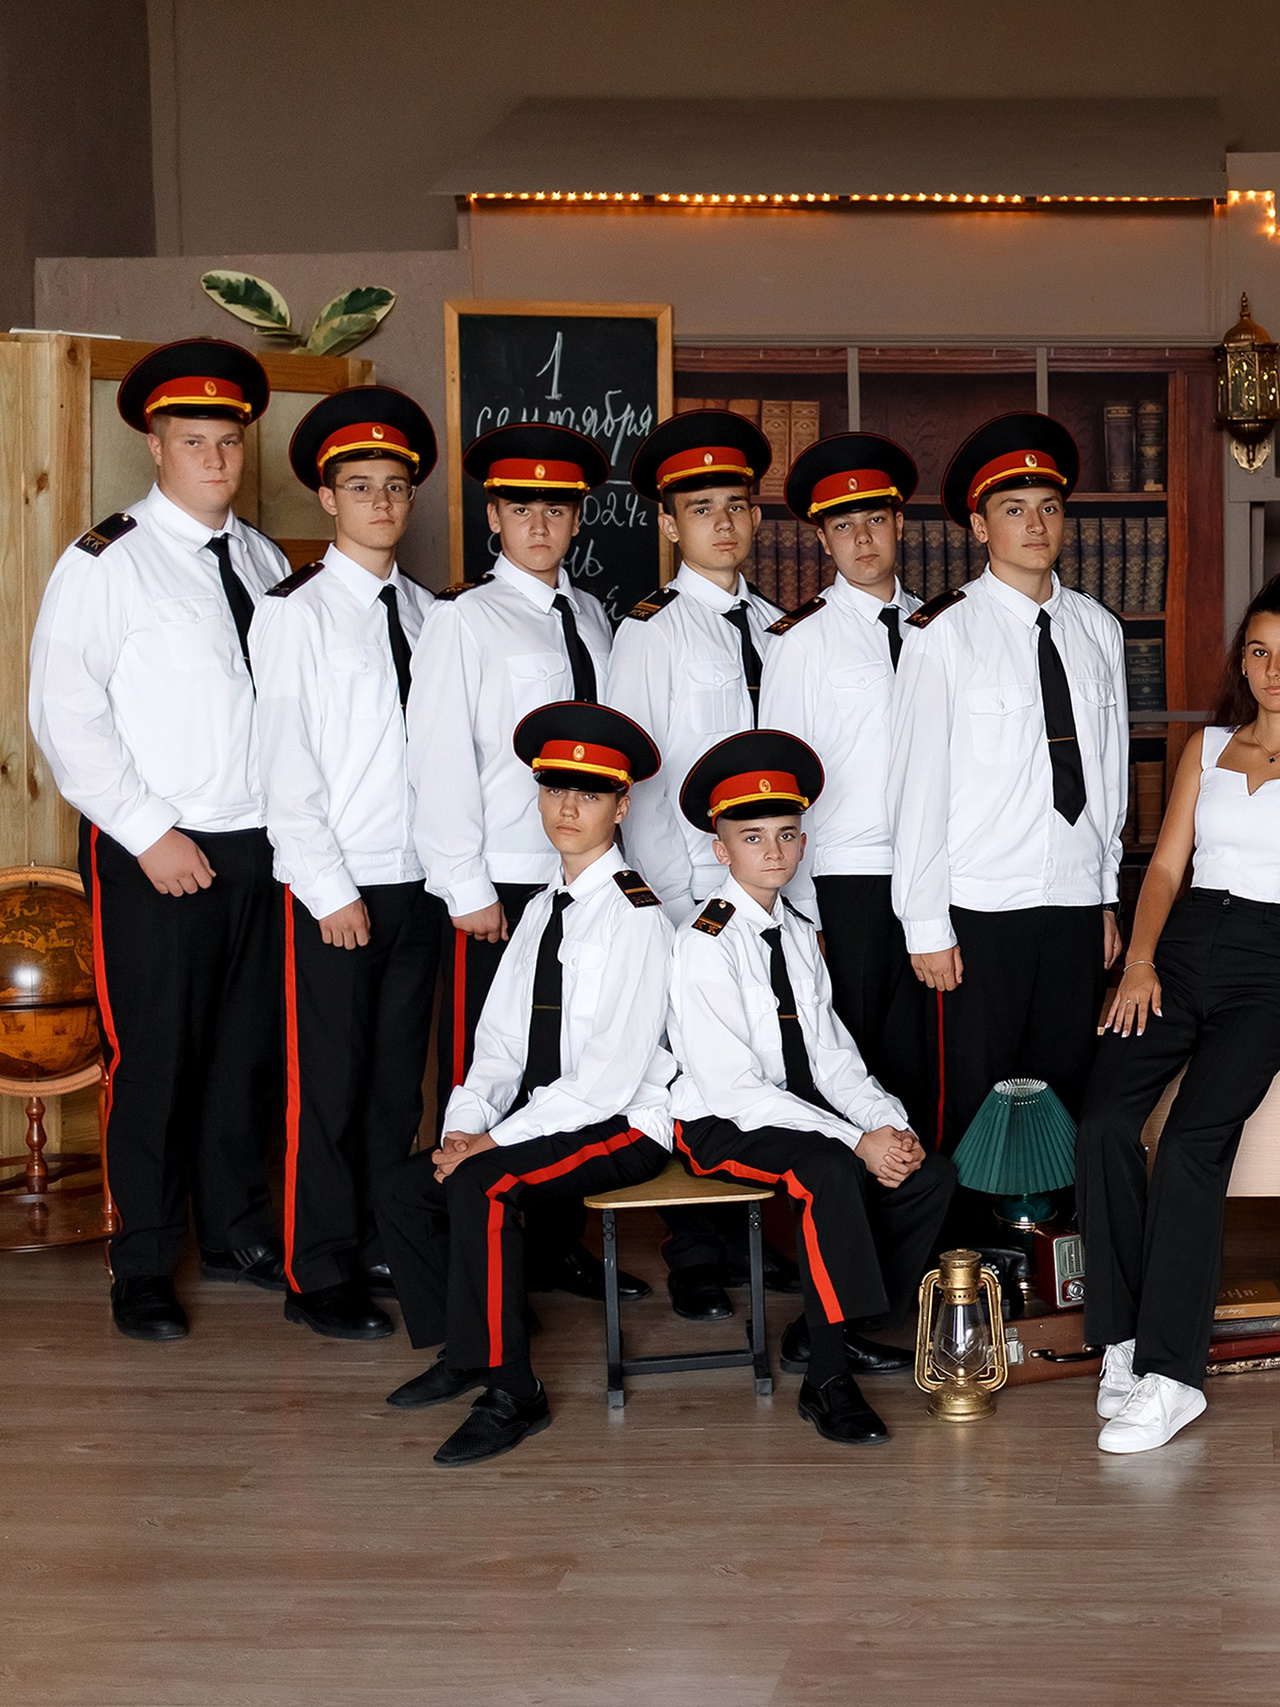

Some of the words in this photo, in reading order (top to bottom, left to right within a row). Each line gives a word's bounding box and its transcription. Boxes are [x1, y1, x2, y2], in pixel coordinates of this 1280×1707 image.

[536, 331, 563, 400] 1
[579, 491, 648, 527] 024г
[83, 535, 104, 550] КК
